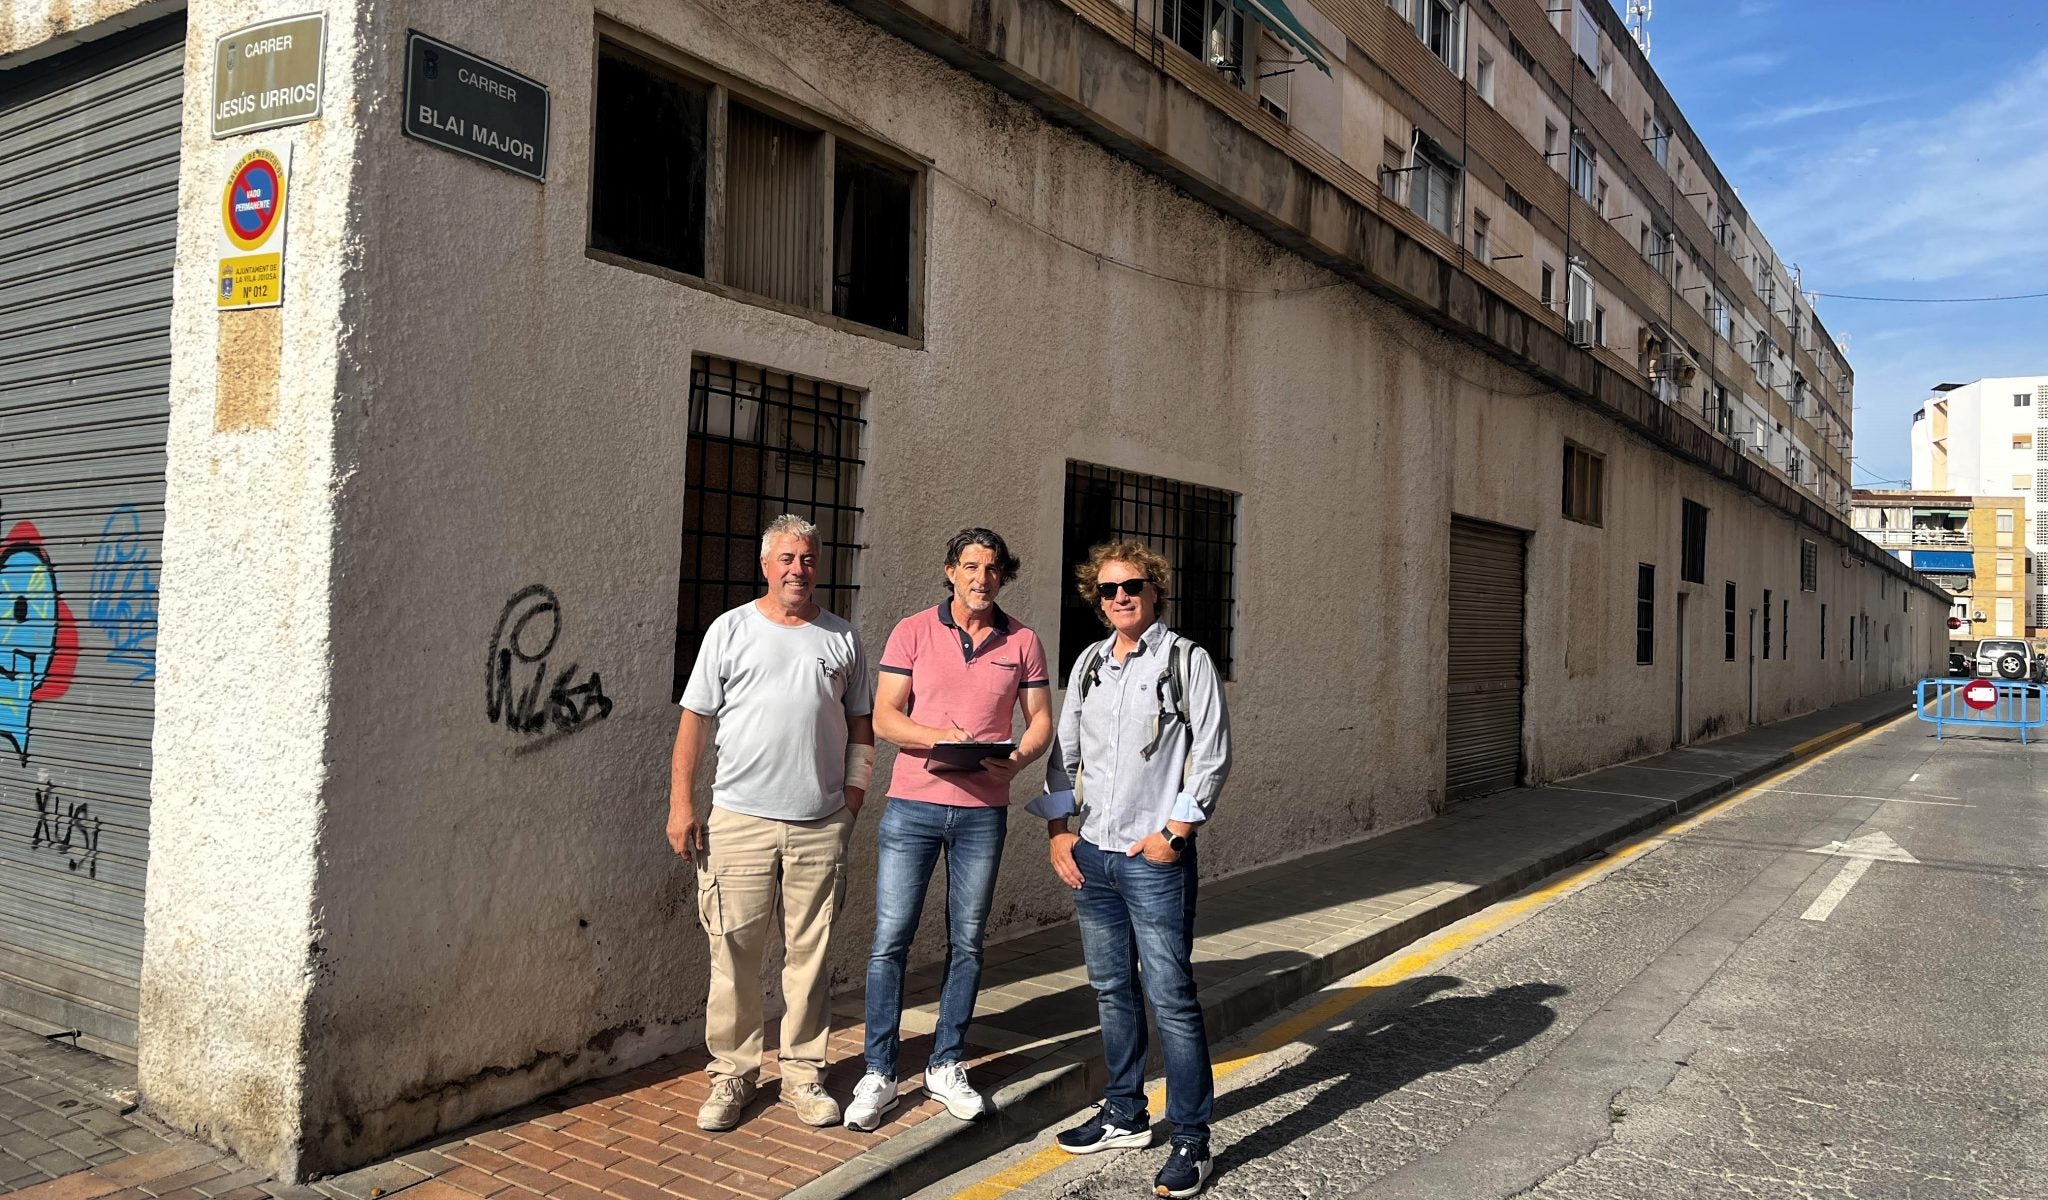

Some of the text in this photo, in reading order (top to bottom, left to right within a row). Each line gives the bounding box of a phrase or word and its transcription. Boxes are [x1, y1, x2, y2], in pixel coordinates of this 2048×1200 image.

[245, 35, 292, 58] CARRER
[458, 68, 517, 102] CARRER
[216, 83, 316, 120] JESÚS URRIOS
[419, 105, 534, 162] BLAI MAJOR
[228, 158, 247, 187] SALIDA
[248, 151, 256, 161] DE
[246, 188, 262, 199] VADO
[235, 199, 271, 213] PERMANENTE
[235, 263, 278, 275] AJUNTAMENT DE
[235, 272, 278, 284] LA VILA JOIOSA
[253, 285, 268, 298] 012
